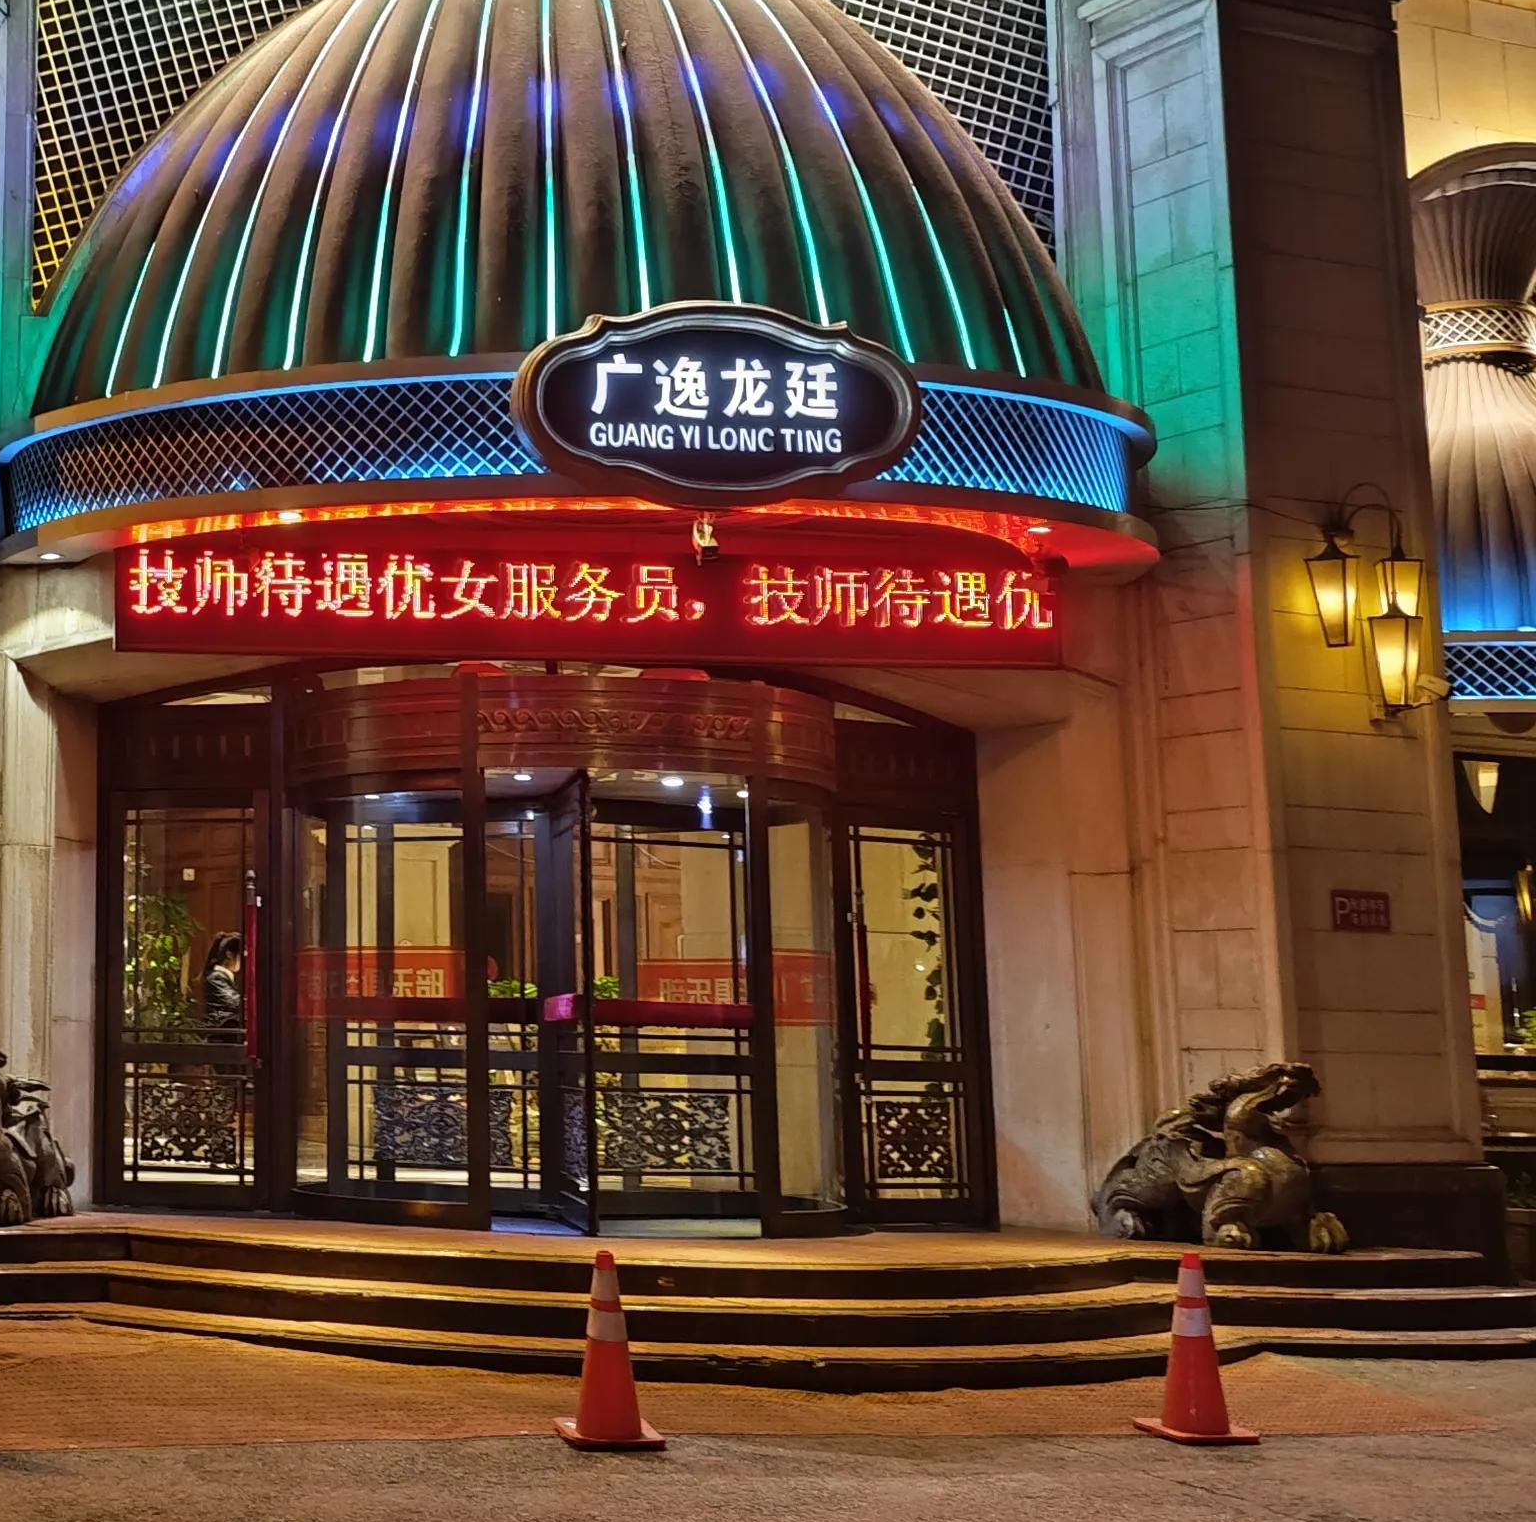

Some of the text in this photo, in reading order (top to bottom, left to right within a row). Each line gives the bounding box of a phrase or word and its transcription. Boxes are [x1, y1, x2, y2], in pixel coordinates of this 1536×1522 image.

[590, 353, 839, 420] 广逸龙廷
[590, 422, 674, 450] GUANG
[679, 425, 701, 450] YI
[780, 428, 843, 454] TING
